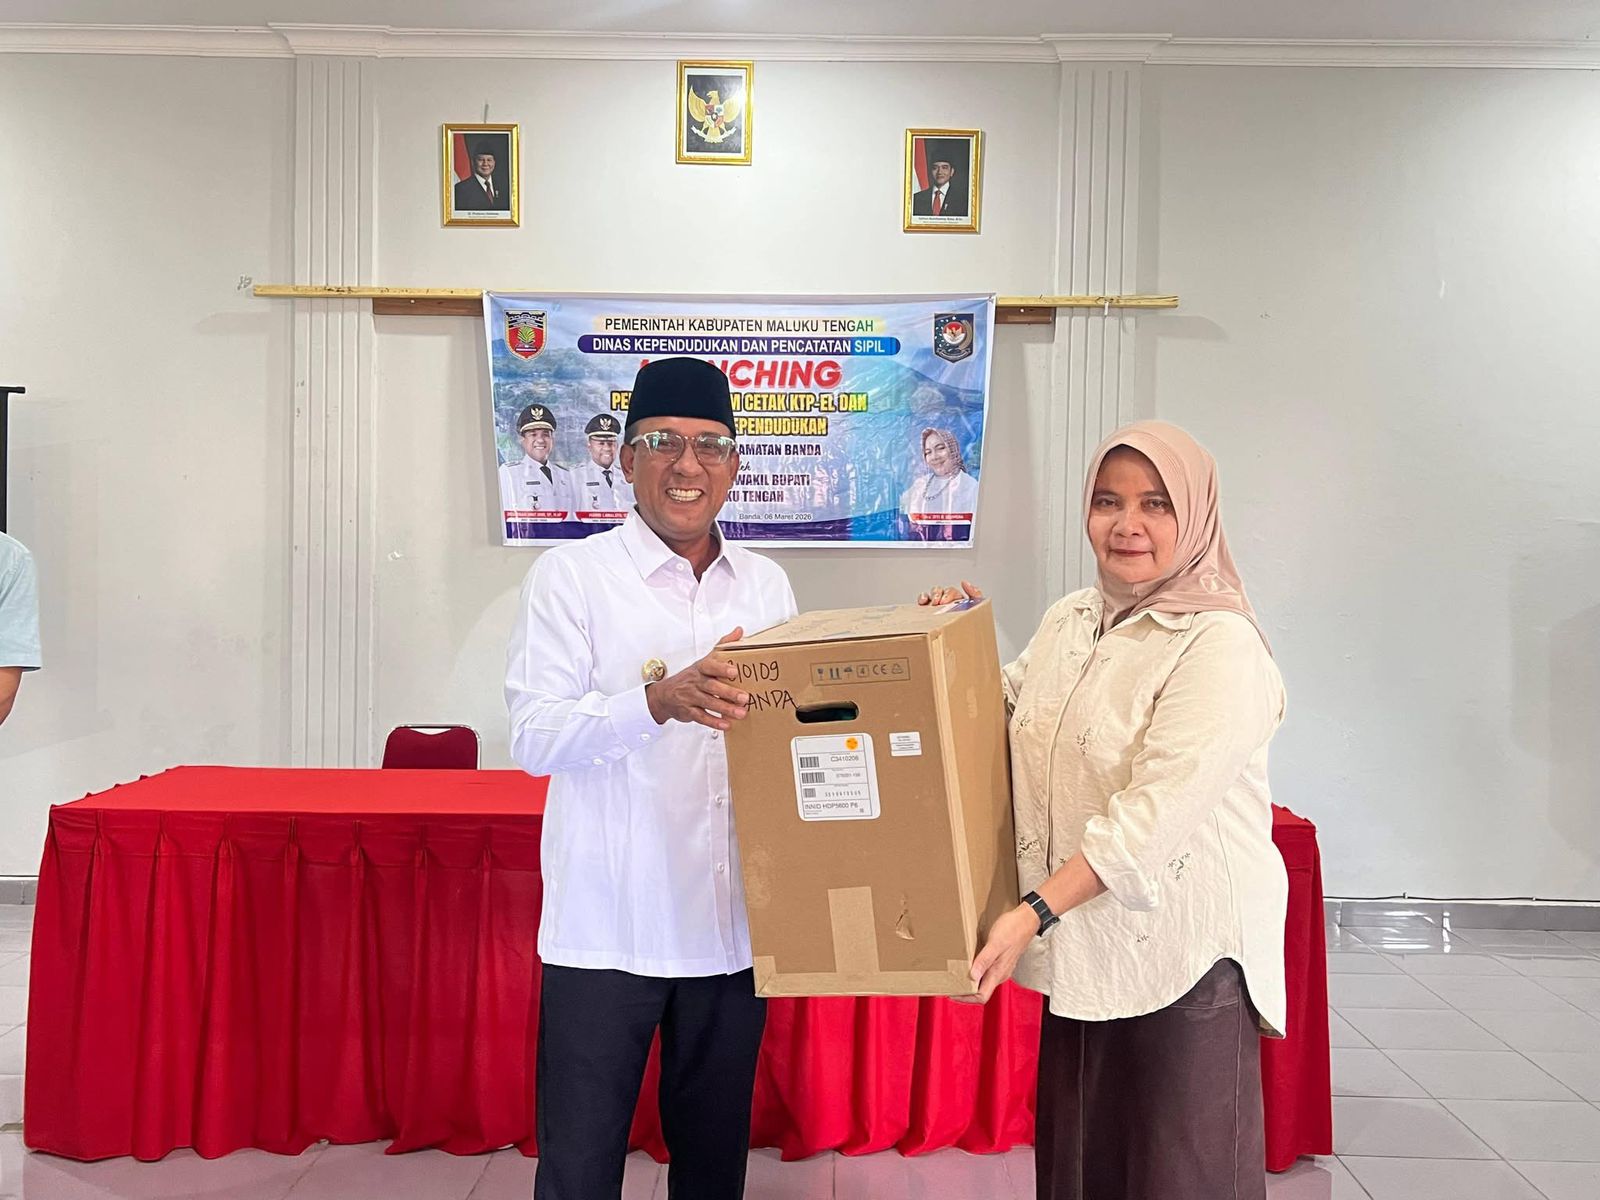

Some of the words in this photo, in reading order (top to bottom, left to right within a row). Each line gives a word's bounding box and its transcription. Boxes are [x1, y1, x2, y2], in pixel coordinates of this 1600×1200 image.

[605, 318, 684, 331] PEMERINTAH
[689, 318, 762, 332] KABUPATEN
[766, 320, 818, 332] MALUKU
[822, 320, 873, 332] TENGAH
[592, 337, 631, 351] DINAS
[634, 338, 738, 352] KEPENDUDUKAN
[741, 340, 768, 352] DAN
[771, 340, 850, 353] PENCATATAN
[854, 340, 885, 352] SIPIL
[744, 393, 788, 412] CETAK
[789, 393, 837, 412] KTP-EL
[838, 393, 868, 412] DAN
[738, 444, 782, 456] AMATAN
[784, 444, 821, 456] BANDA
[772, 474, 810, 486] BUPATI
[743, 490, 784, 502] TENGAH
[744, 690, 800, 712] ANDA
